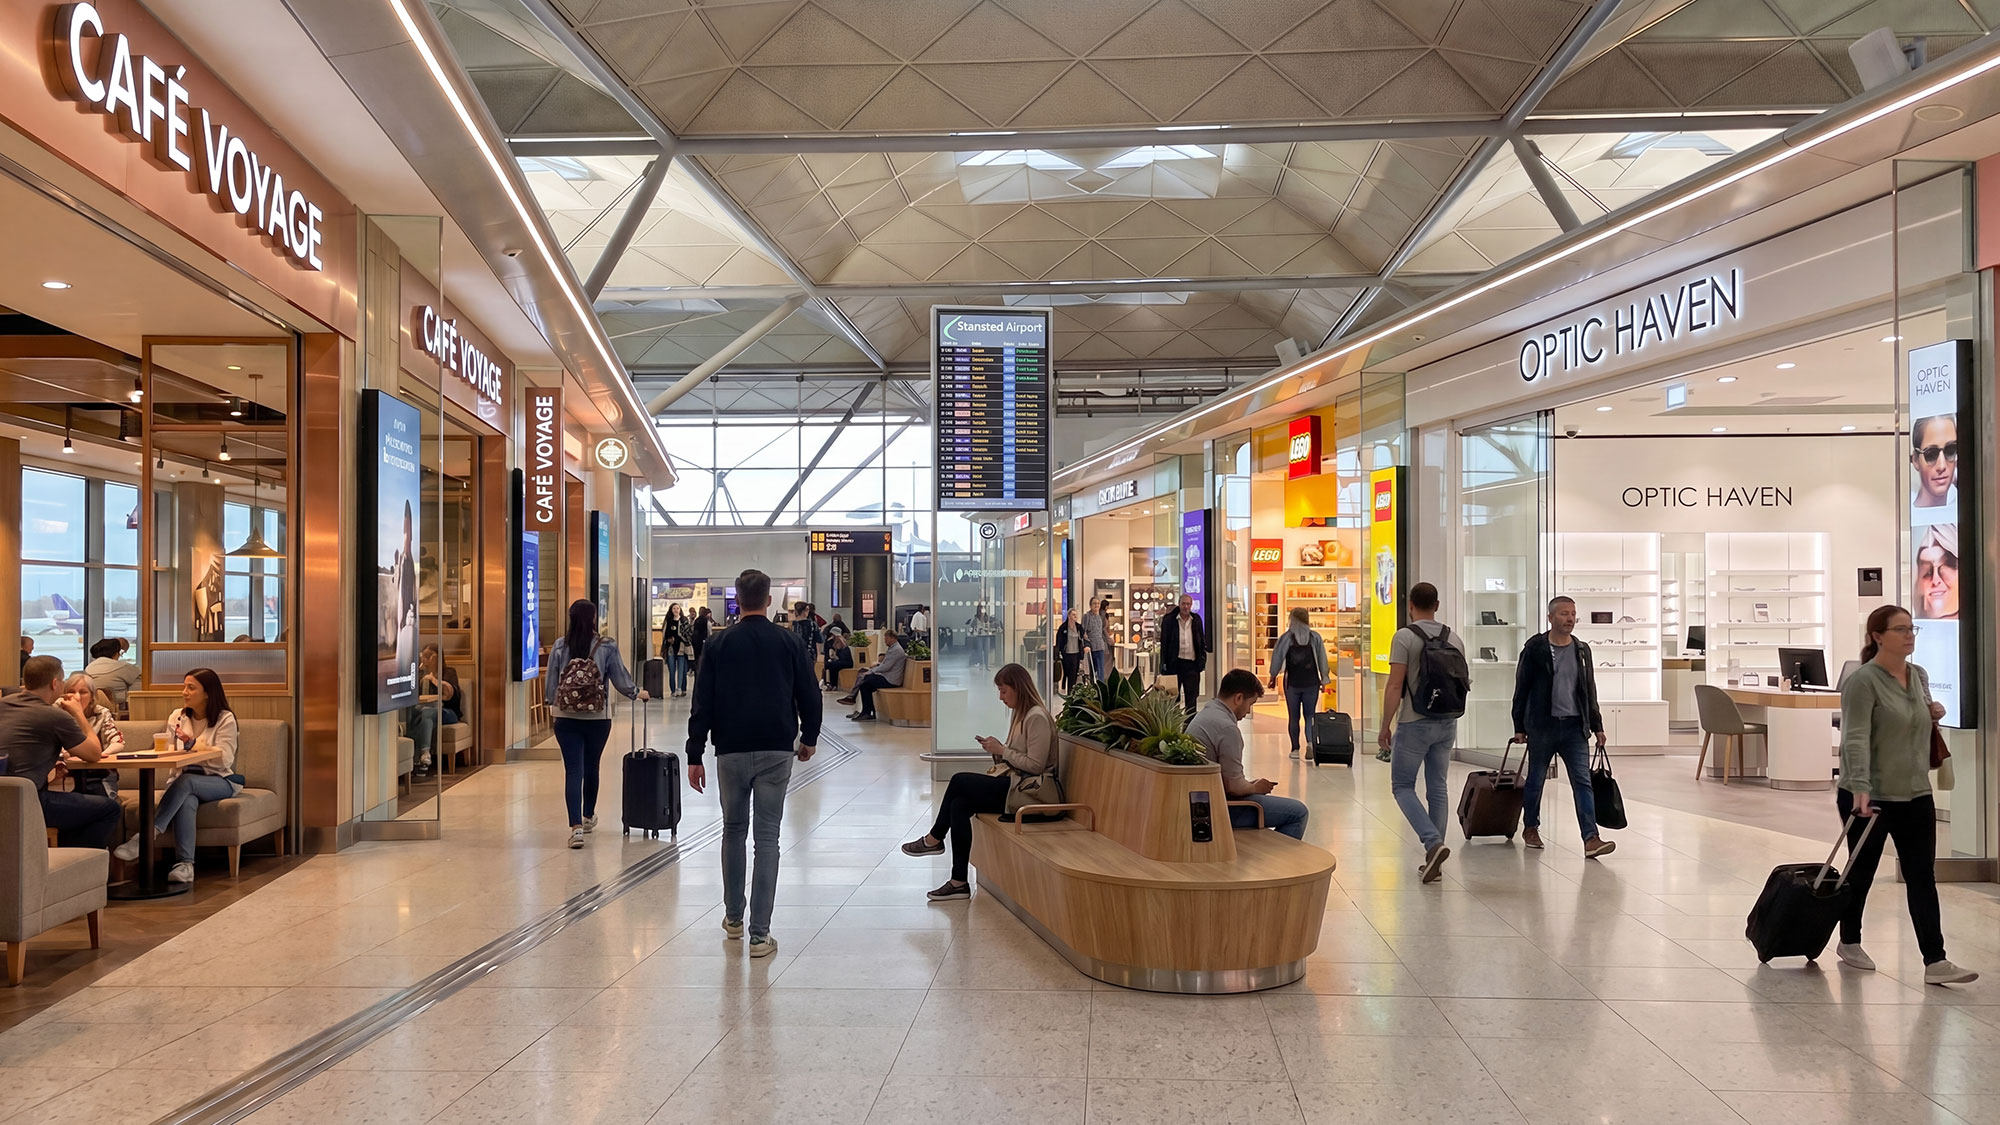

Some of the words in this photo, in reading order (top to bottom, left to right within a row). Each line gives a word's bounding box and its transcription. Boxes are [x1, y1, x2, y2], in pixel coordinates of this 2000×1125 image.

[70, 2, 190, 172] CAFÉ
[202, 107, 324, 272] VOYAGE
[957, 321, 1003, 332] Stansted
[1006, 322, 1042, 334] Airport
[1519, 317, 1603, 382] OPTIC
[1615, 268, 1738, 355] HAVEN
[423, 306, 458, 371] CAFÉ
[459, 336, 503, 406] VOYAGE
[1917, 364, 1949, 382] OPTIC
[1915, 379, 1951, 396] HAVEN
[536, 396, 553, 471] VOYAGE
[1290, 434, 1311, 462] LEGO
[1622, 486, 1697, 507] OPTIC
[1707, 486, 1792, 507] HAVEN
[1253, 549, 1280, 561] LEGO
